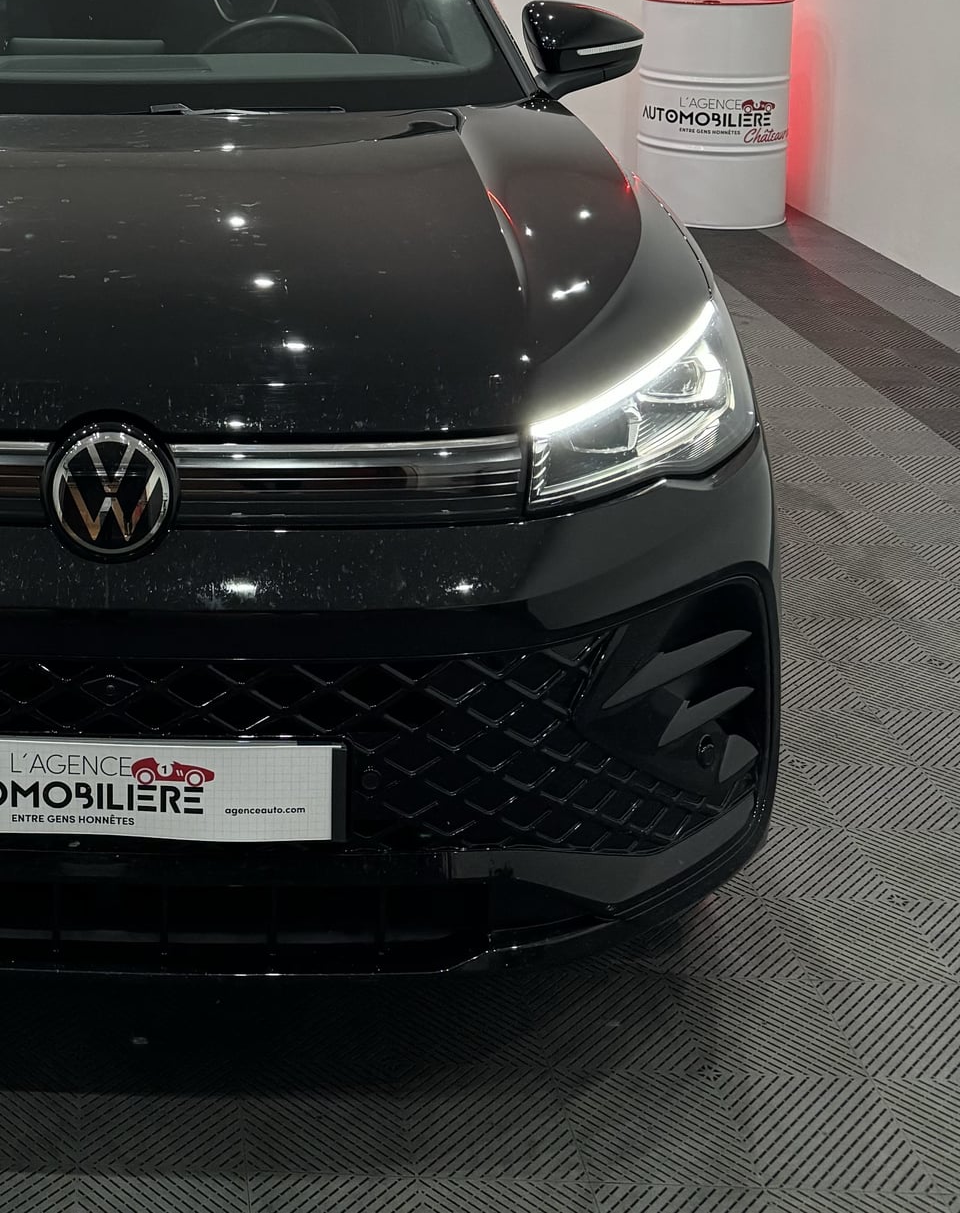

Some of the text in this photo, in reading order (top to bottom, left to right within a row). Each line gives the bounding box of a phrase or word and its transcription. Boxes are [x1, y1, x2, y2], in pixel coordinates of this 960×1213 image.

[10, 752, 132, 777] L'AGENCE
[224, 806, 306, 816] agenceauto.com
[11, 814, 135, 826] ENTRE GENS HONNÊTES
